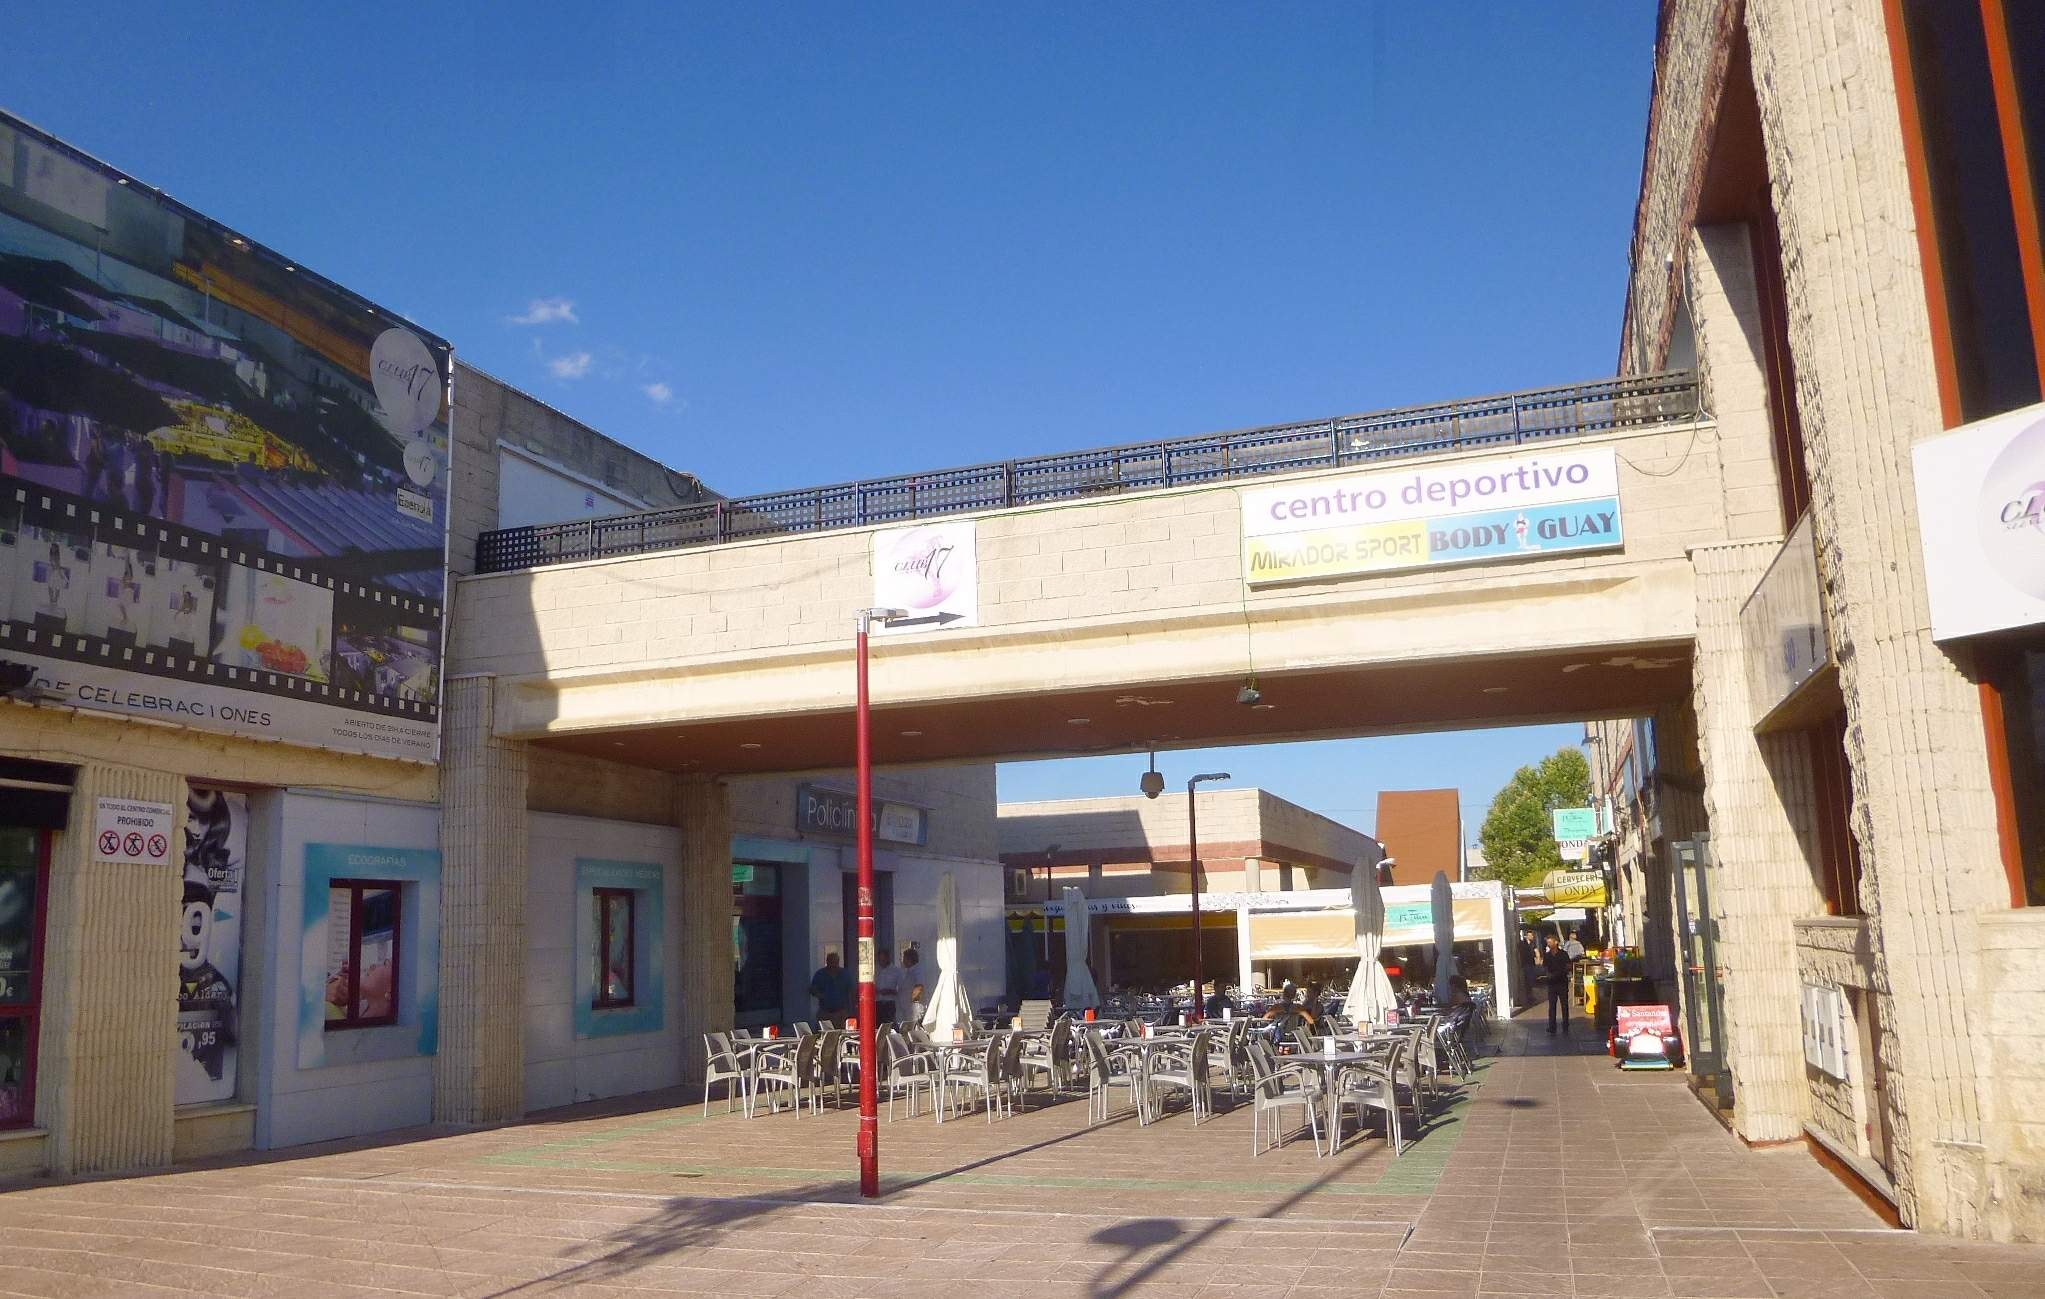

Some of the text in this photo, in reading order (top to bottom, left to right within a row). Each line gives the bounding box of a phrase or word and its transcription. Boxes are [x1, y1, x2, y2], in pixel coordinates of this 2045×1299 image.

[1270, 461, 1589, 521] centro deportivo
[1429, 511, 1615, 553] BODY GUAY
[1250, 533, 1422, 572] MIRADOR SPORT
[78, 685, 272, 727] CELEBRACIONES
[332, 728, 358, 738] TODOS
[344, 718, 375, 730] ABIERTO
[117, 816, 154, 827] PROHIBIDO
[1564, 885, 1597, 897] ONDA
